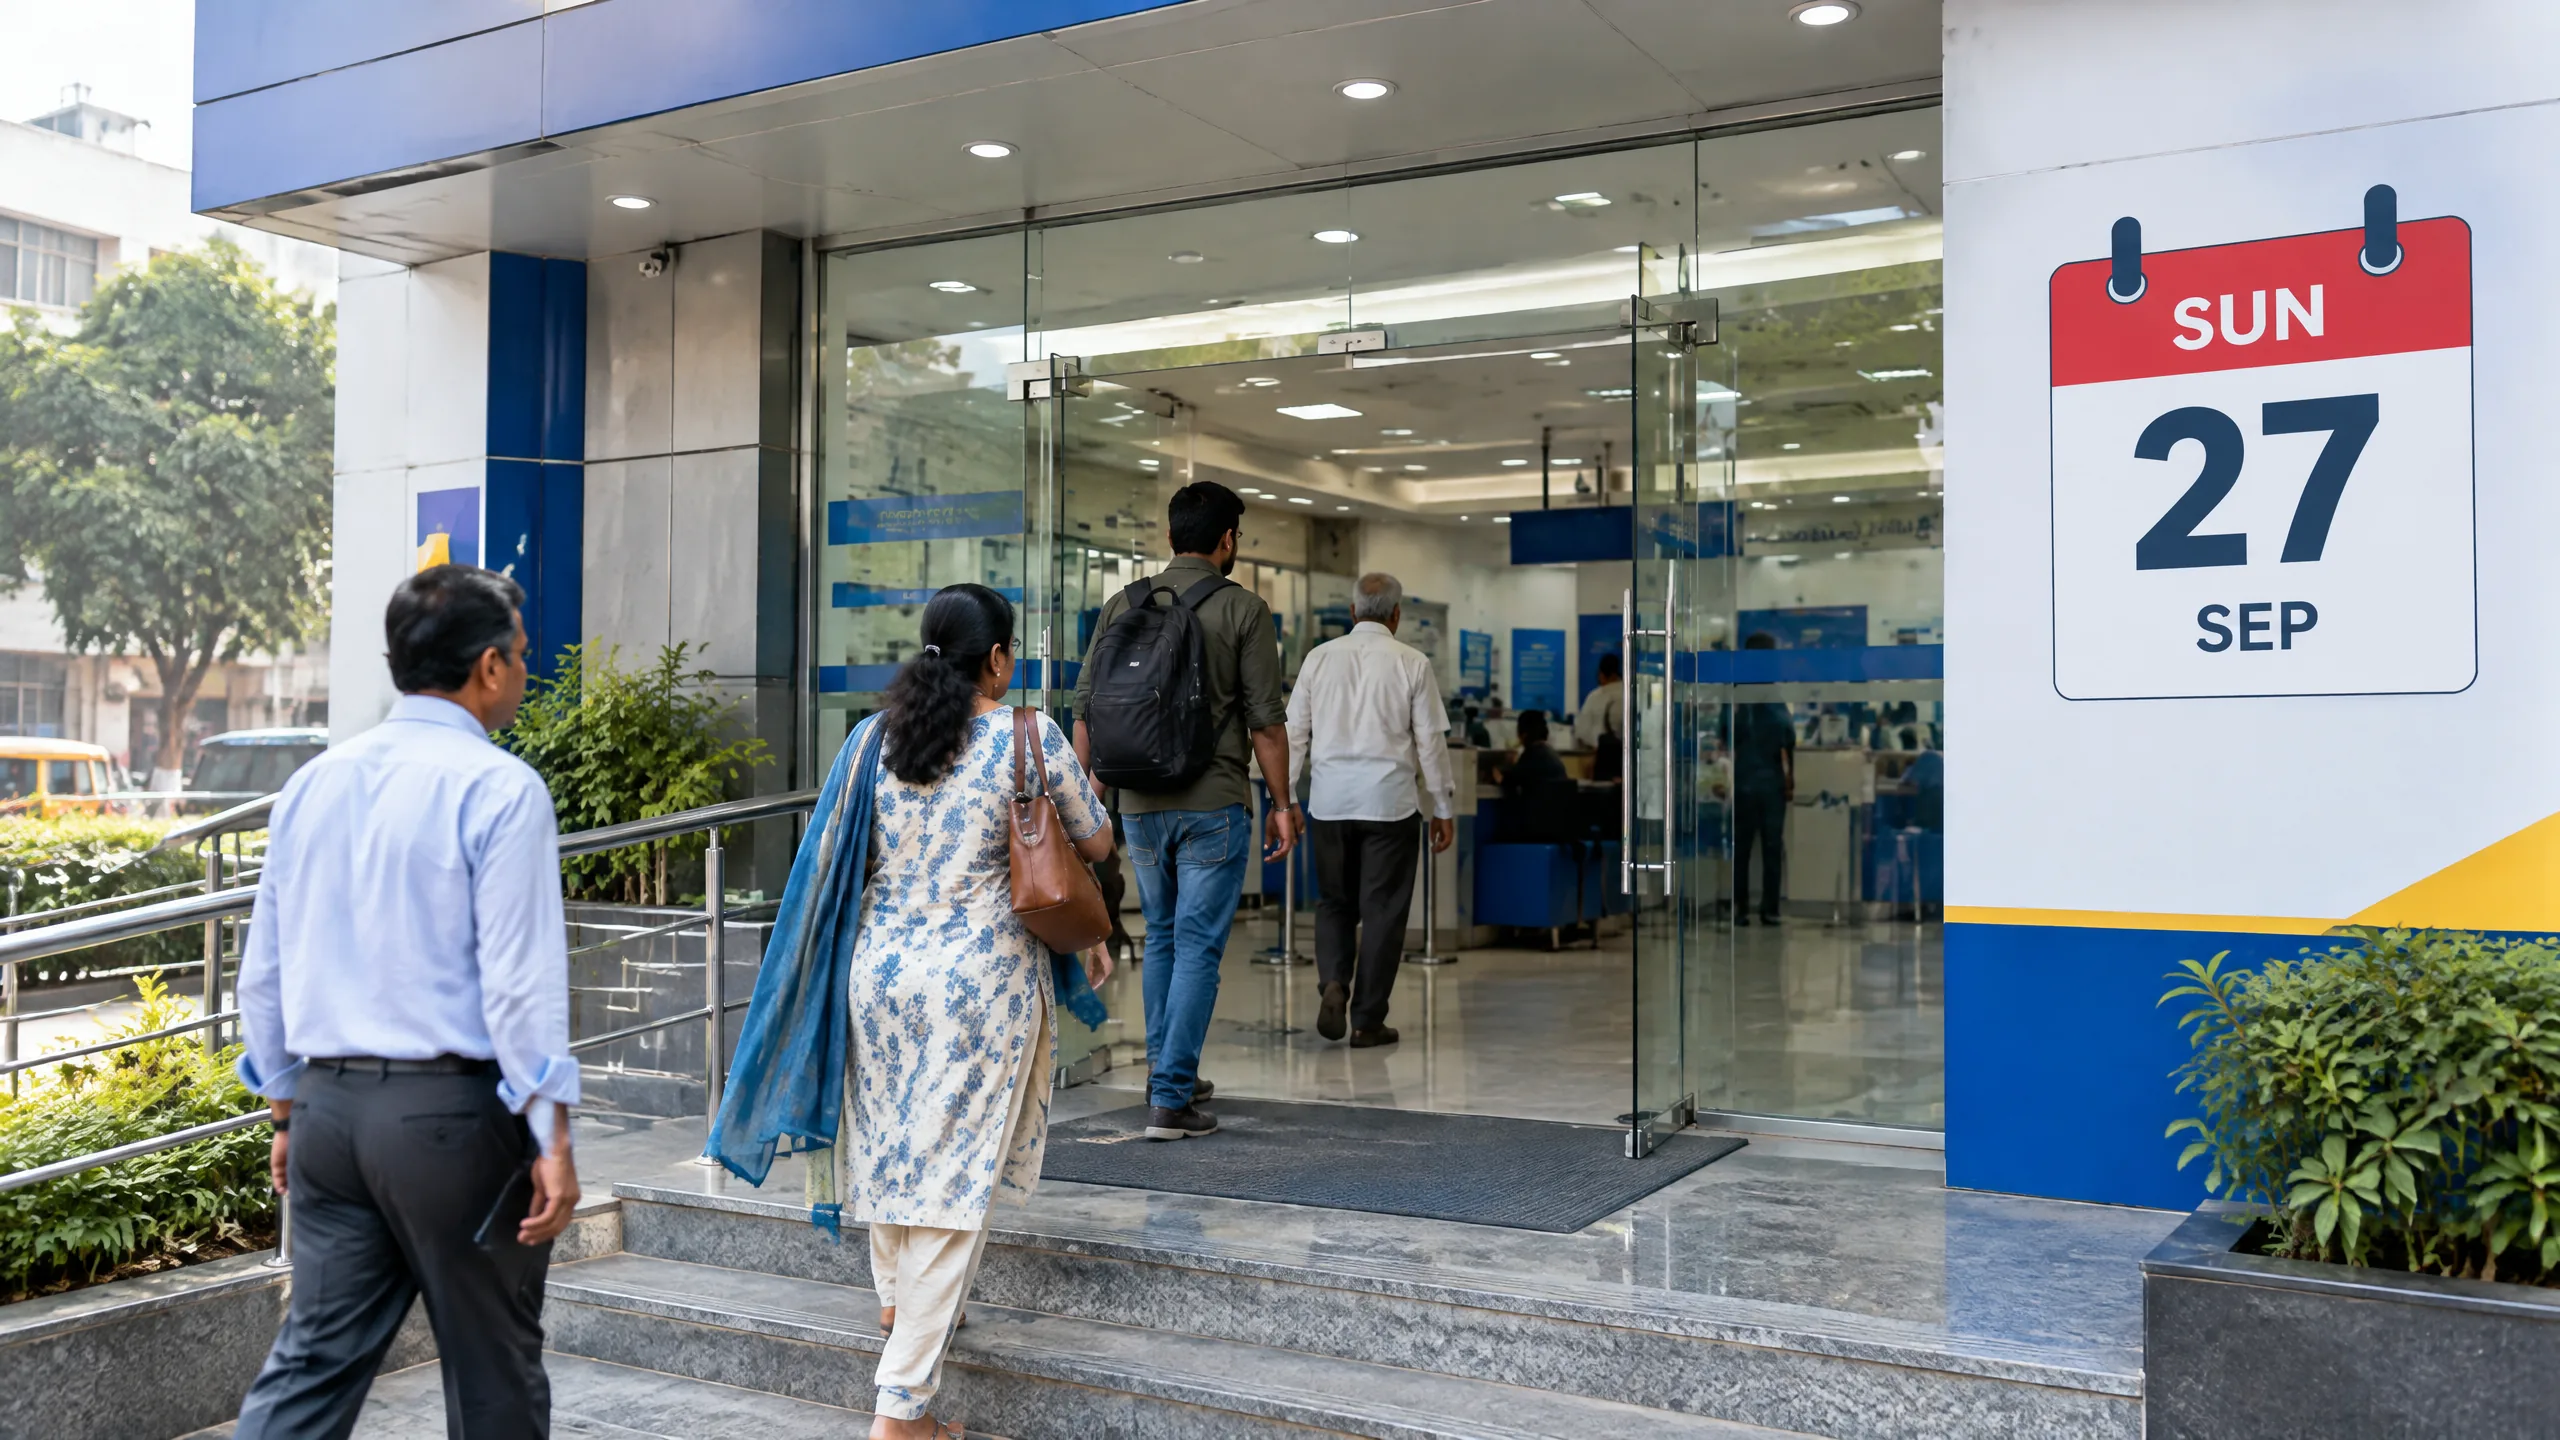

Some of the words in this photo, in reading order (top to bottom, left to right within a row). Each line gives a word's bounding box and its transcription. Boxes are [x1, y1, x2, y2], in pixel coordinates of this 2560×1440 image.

[2173, 284, 2323, 350] SUN
[2134, 393, 2379, 570] 27
[2197, 601, 2318, 652] SEP
